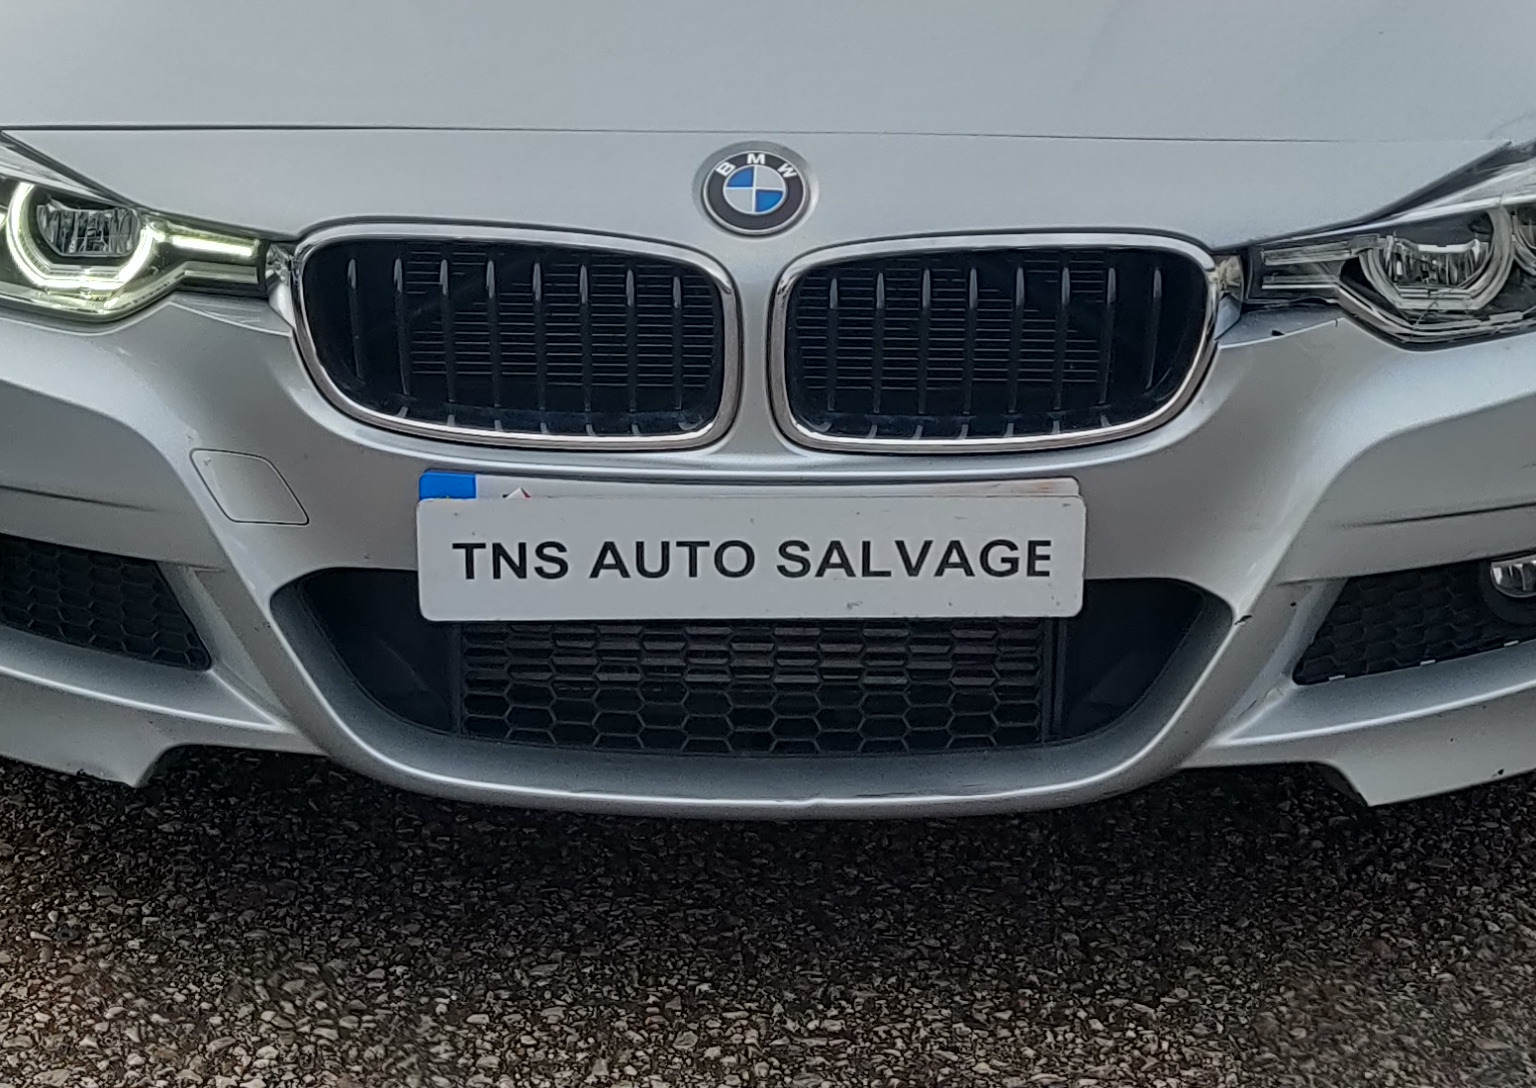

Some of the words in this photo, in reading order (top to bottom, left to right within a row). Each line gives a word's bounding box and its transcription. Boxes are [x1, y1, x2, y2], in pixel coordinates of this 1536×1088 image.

[715, 153, 798, 178] BMW
[452, 540, 569, 580] TNS
[589, 540, 755, 580] AUTO
[776, 539, 1052, 579] SALVAGE
